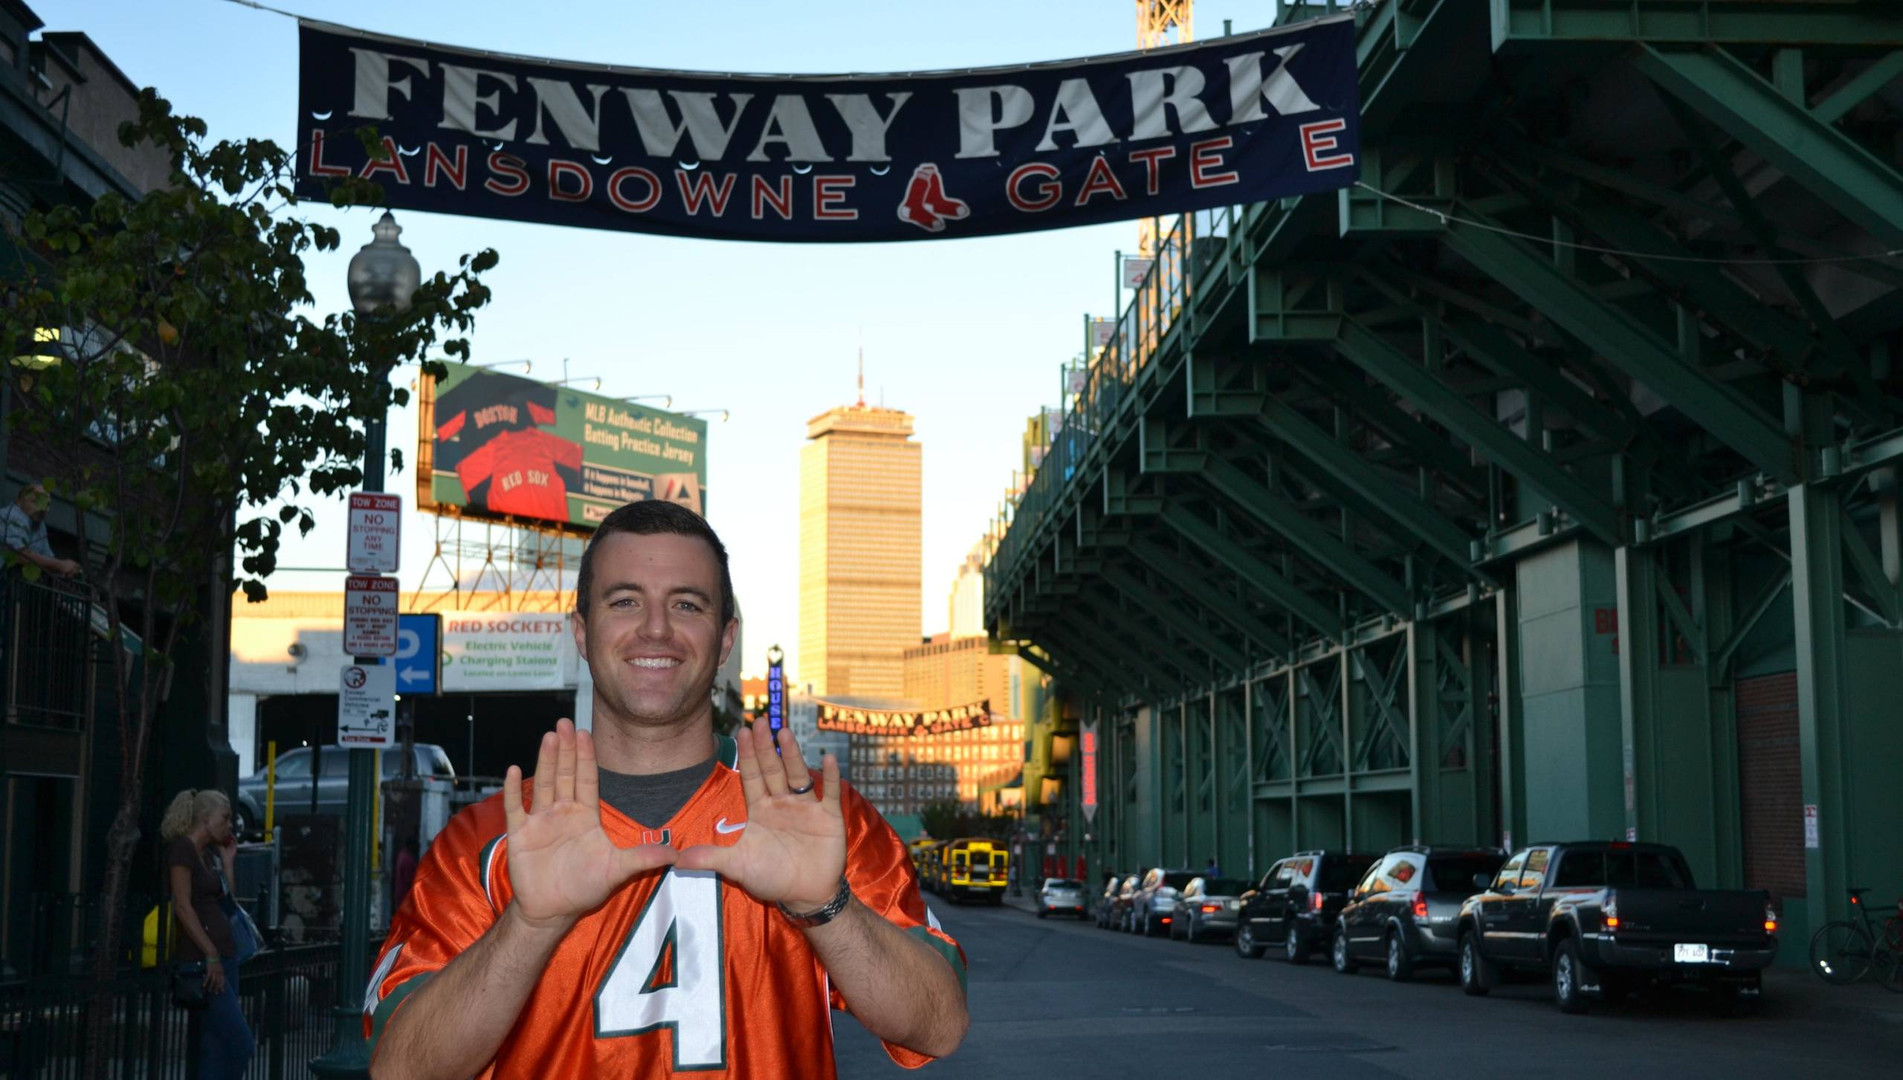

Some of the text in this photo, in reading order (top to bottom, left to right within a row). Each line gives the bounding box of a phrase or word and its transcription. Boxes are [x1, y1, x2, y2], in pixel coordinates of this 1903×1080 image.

[347, 43, 1322, 162] FENWAY PARK
[309, 118, 1354, 220] LANSDOWNE GATE E
[585, 402, 698, 445] MLB Authentic Collection
[585, 423, 694, 467] Batting Practice Jersey
[501, 470, 549, 492] RED SOX
[352, 497, 397, 509] TOW ZONE
[364, 514, 384, 525] NO
[353, 525, 395, 534] STOPPING
[364, 542, 382, 551] TIME
[348, 580, 396, 590] TOW ZONE
[362, 595, 381, 605] NO
[349, 607, 396, 616] STOPPING
[448, 620, 563, 633] RED SOCKETS
[466, 640, 553, 651] Electric Vehicle
[460, 655, 513, 667] Charging
[769, 666, 782, 730] HOUSE
[824, 702, 985, 727] FENWAY PARK
[817, 717, 908, 735] LANSDOWNE
[931, 718, 972, 733] GATE
[594, 865, 727, 1072] 4
